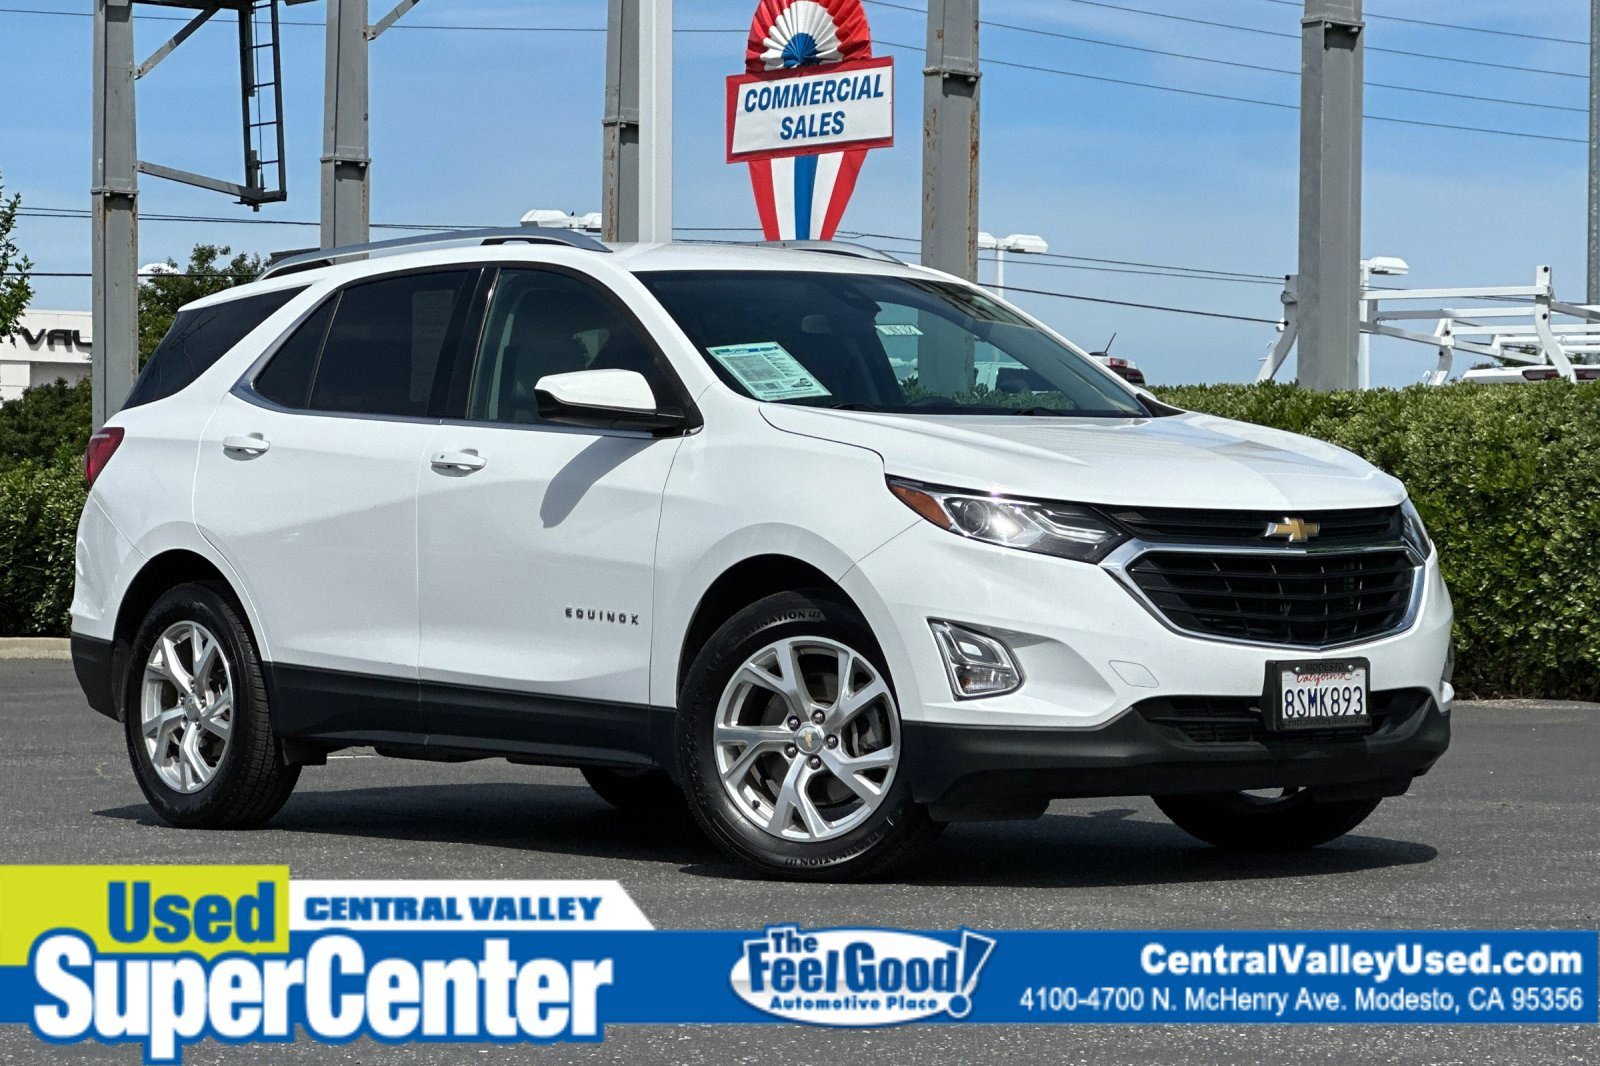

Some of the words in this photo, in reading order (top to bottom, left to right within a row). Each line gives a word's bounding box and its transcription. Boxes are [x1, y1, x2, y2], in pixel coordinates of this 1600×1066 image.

[744, 74, 885, 113] COMMERCIAL
[780, 110, 846, 140] SALES
[564, 607, 639, 626] EQUINOX
[1296, 671, 1351, 686] California
[1305, 662, 1345, 672] MODESTO
[1284, 686, 1363, 718] 8SMK893
